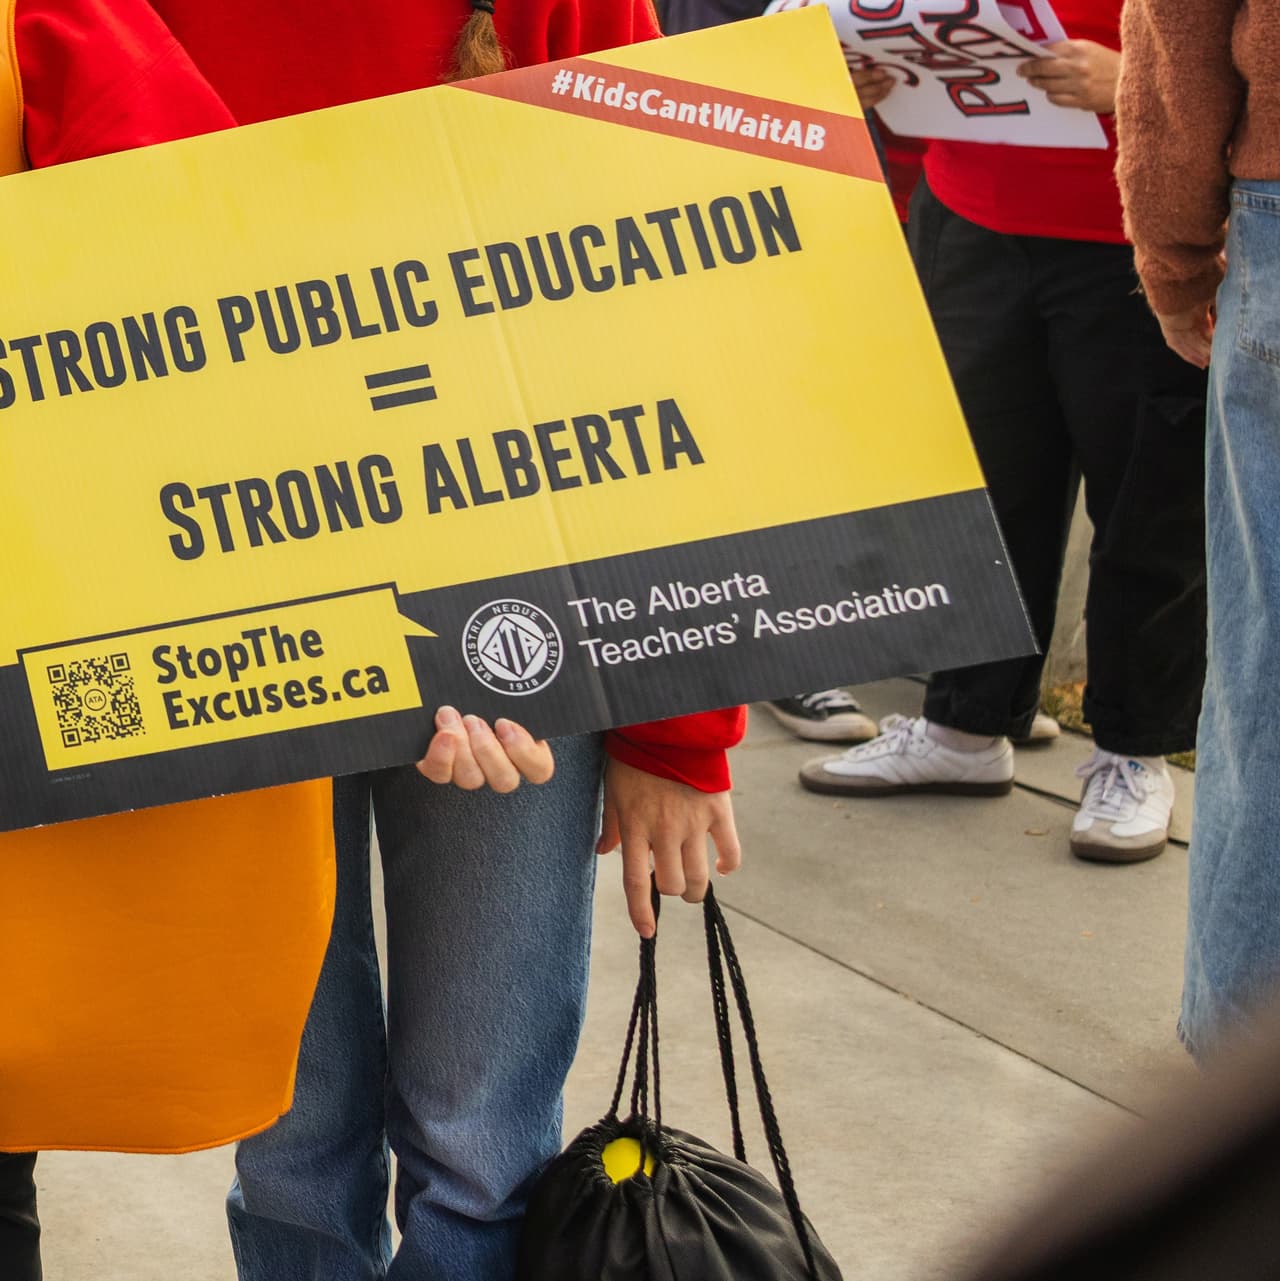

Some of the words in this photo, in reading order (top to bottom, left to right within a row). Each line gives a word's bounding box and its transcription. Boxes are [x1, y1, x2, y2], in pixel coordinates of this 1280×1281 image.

[551, 69, 827, 152] #KidsCantWaitAB
[217, 259, 439, 363] PUBLIC
[448, 185, 803, 318] EDUCATION
[158, 453, 404, 562] STRONG
[421, 397, 706, 515] ALBERTA
[492, 604, 539, 620] NEQUE
[567, 597, 637, 628] The
[647, 572, 770, 616] Alberta
[578, 613, 740, 668] Teachers'
[752, 583, 952, 639] Association
[151, 625, 325, 685] StopThe
[467, 620, 493, 681] MAGISTRI
[544, 631, 558, 671] SERVI
[162, 665, 390, 731] Excuses.ca
[509, 678, 539, 691] 1918
